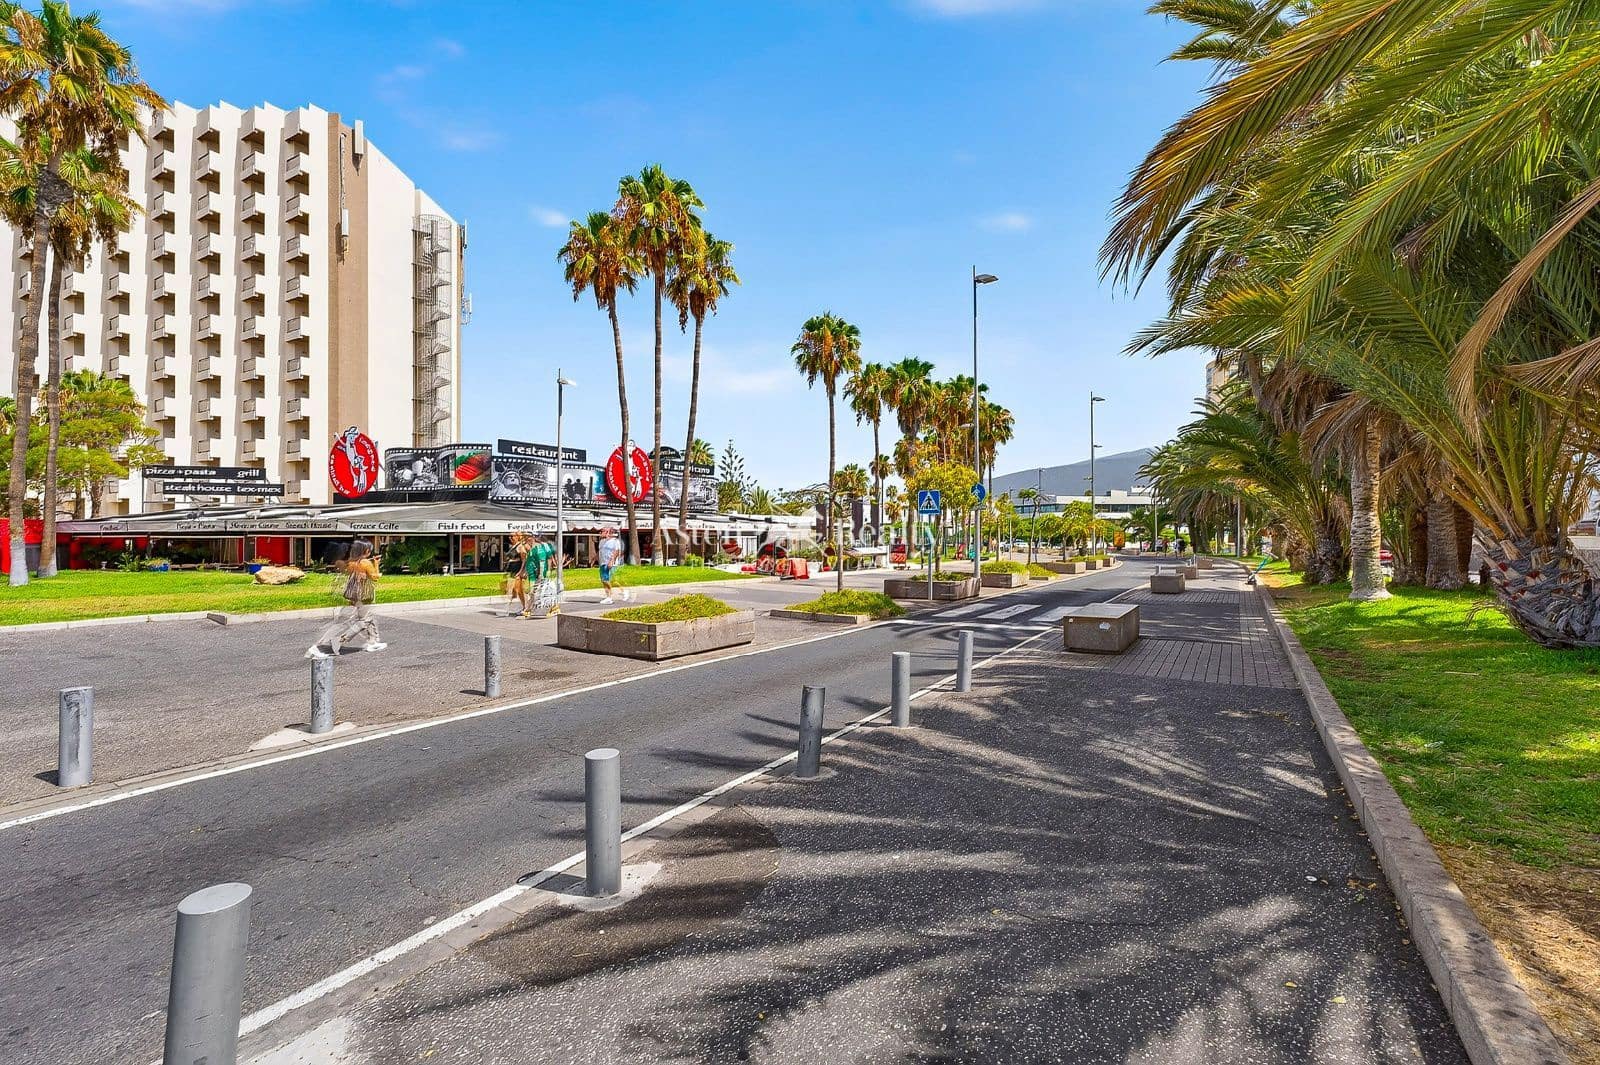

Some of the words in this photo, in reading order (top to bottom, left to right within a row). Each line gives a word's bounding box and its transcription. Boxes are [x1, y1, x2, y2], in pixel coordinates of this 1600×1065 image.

[511, 445, 579, 460] restaurant
[145, 467, 175, 476] pizza
[184, 468, 217, 476] pasta
[236, 468, 260, 478] grill
[164, 483, 196, 492] steak
[196, 484, 233, 493] house
[438, 522, 459, 531] Fish
[460, 522, 486, 531] Food
